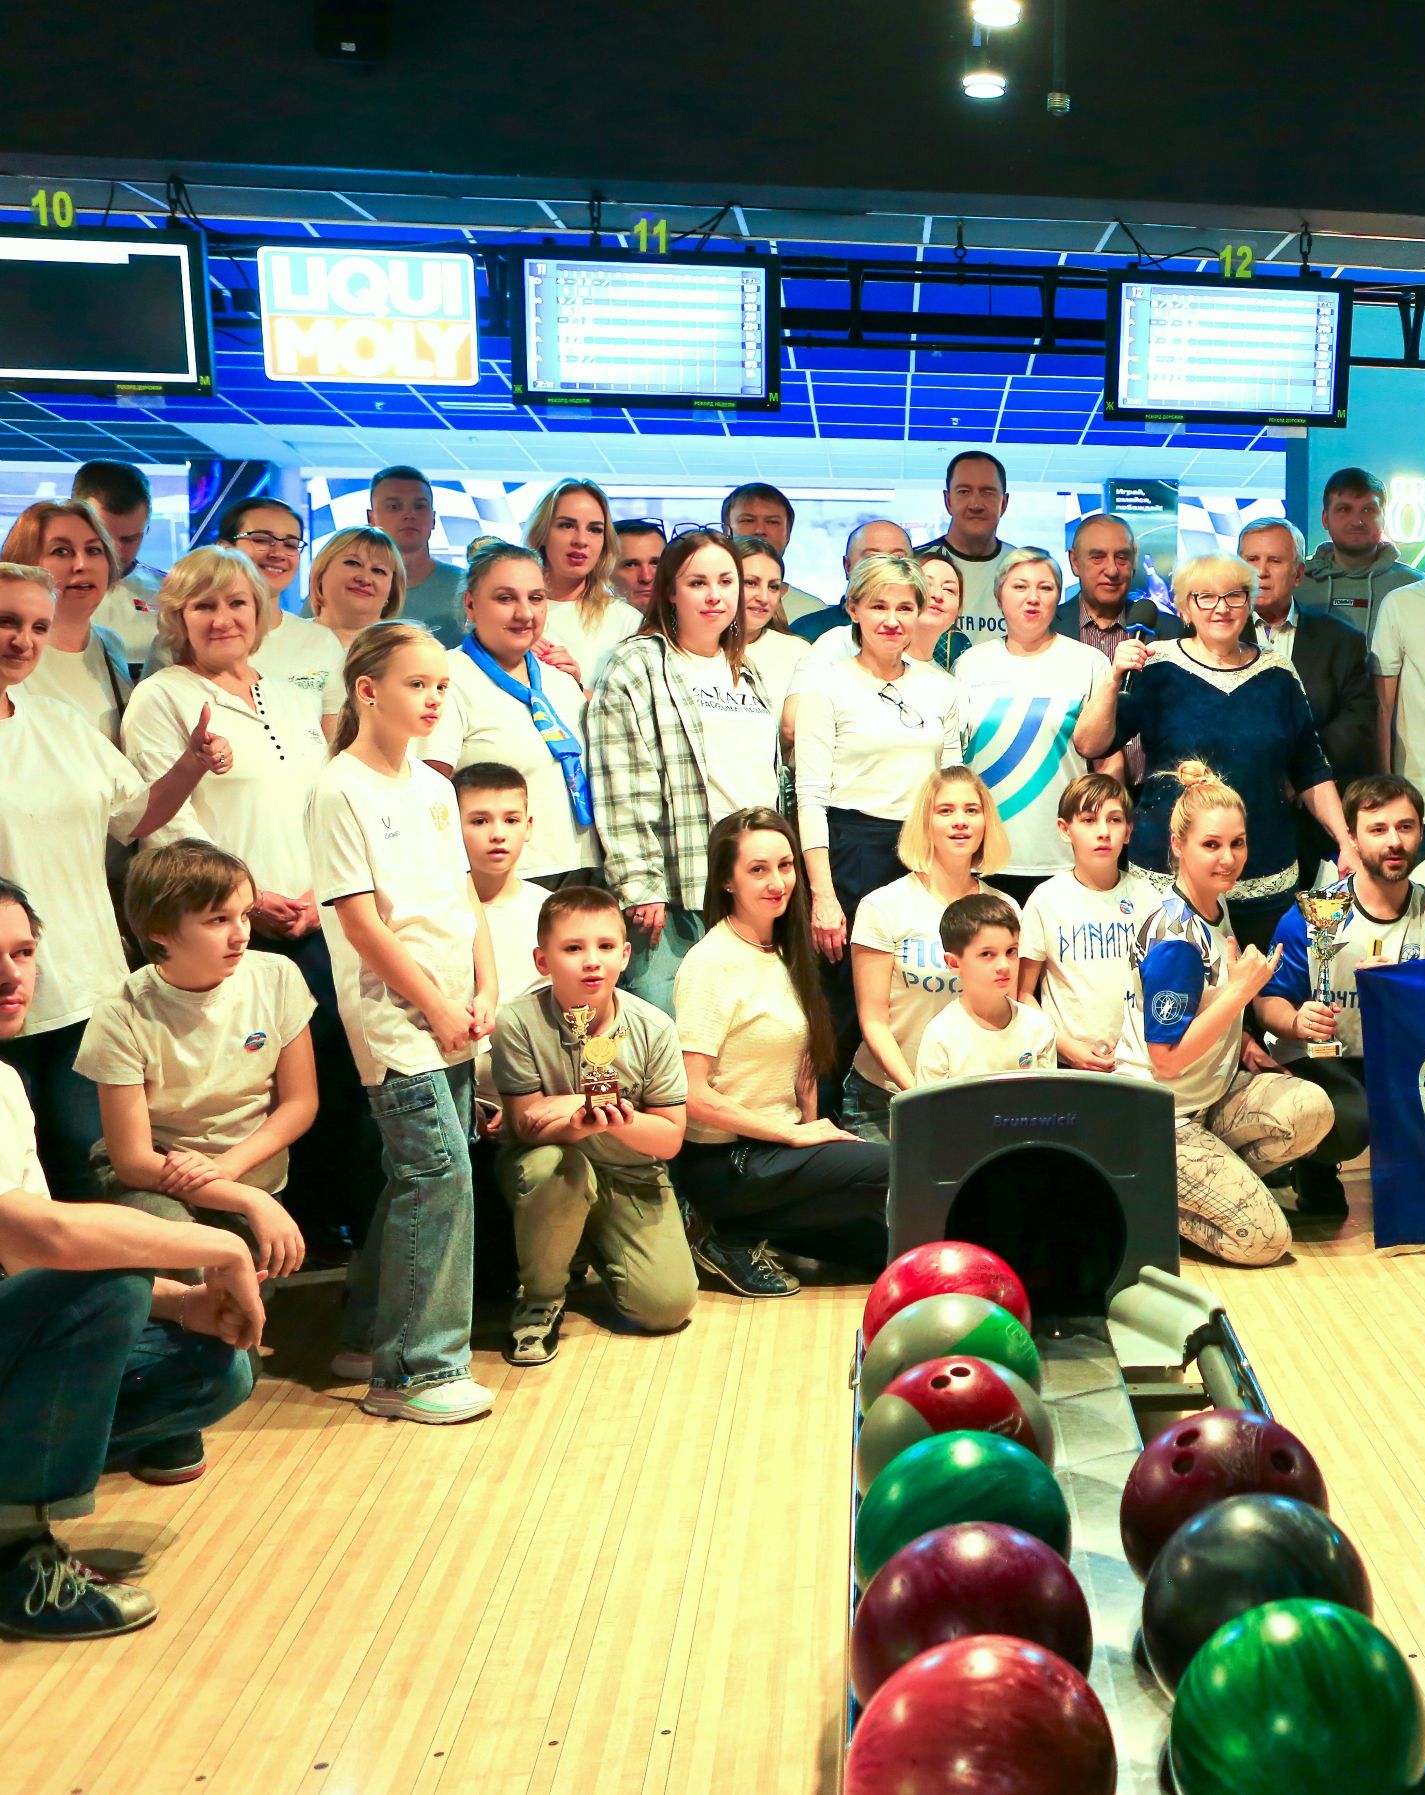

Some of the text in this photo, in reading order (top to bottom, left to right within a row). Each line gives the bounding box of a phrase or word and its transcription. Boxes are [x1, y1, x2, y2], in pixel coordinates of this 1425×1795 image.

[32, 189, 74, 228] 10
[633, 217, 668, 254] 11
[1219, 244, 1254, 278] 12
[271, 253, 465, 316] LIQUI
[274, 317, 471, 379] MOLY
[1115, 488, 1146, 496] Играй,
[1115, 504, 1164, 512] побеждай!
[992, 1112, 1078, 1127] Brunswick
